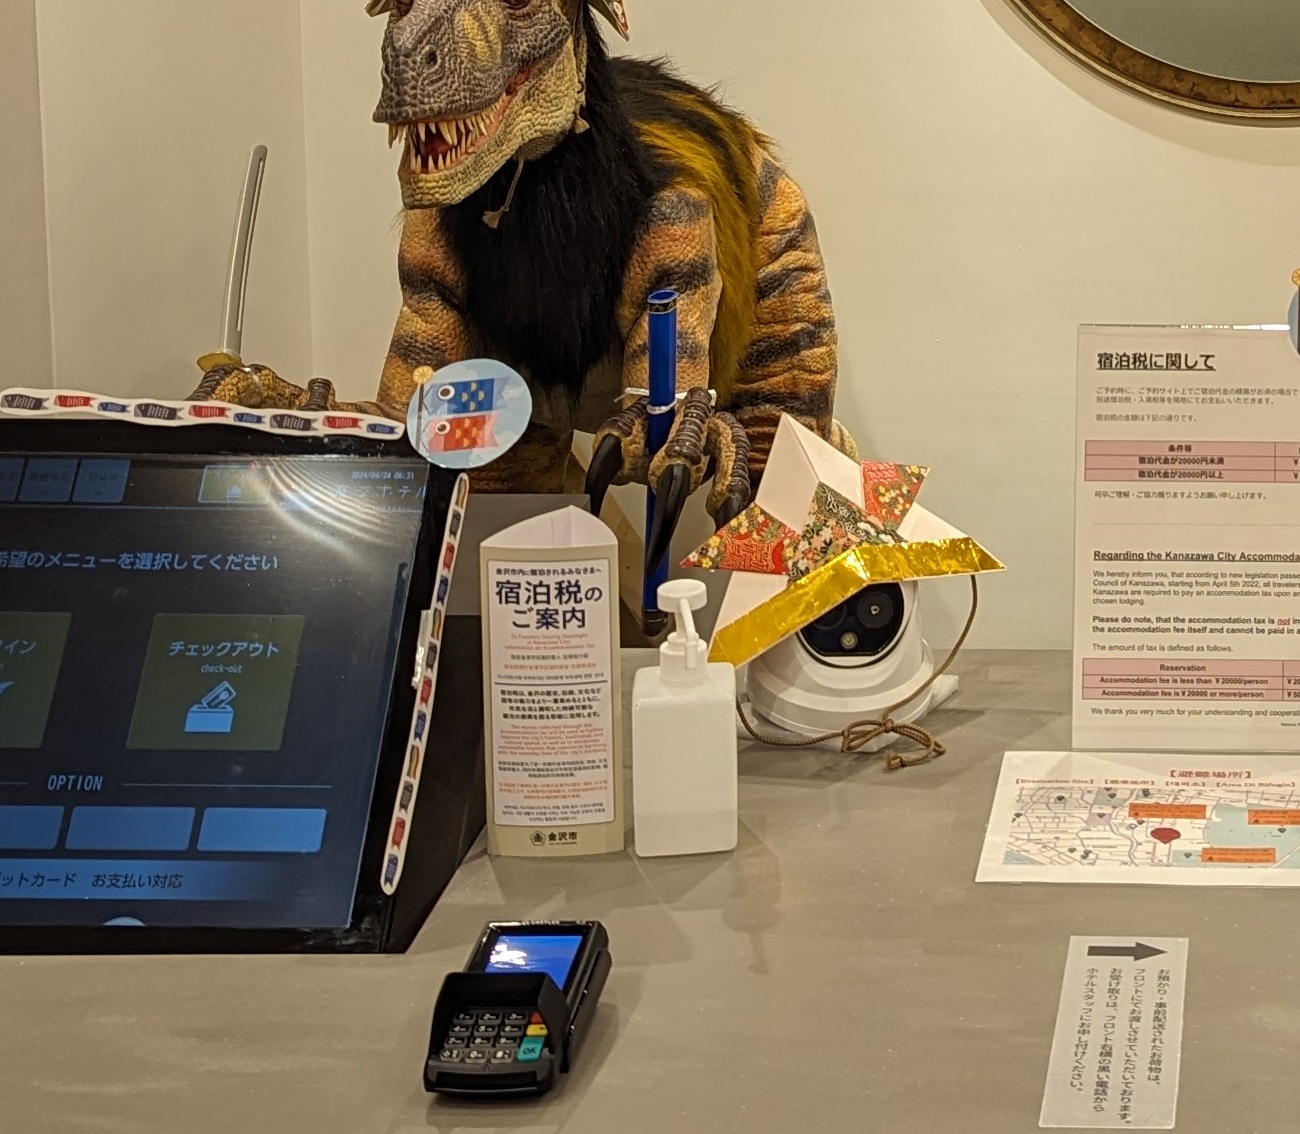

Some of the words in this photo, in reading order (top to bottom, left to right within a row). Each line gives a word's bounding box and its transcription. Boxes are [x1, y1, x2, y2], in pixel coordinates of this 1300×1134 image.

[1097, 352, 1216, 371] 宿泊税に関して
[1093, 551, 1144, 561] Regarding
[1147, 551, 1162, 561] the
[1165, 551, 1214, 561] Kanazawa
[1217, 552, 1236, 562] City
[495, 579, 602, 605] 宿泊税の
[512, 606, 586, 630] ご案内
[169, 641, 279, 657] チェックアウト
[201, 664, 243, 674] check-out
[47, 775, 104, 791] OPTION
[548, 832, 577, 842] 金沢市
[0, 872, 77, 887] ットカード
[92, 873, 184, 889] お支払い対応
[523, 1047, 536, 1055] OK
